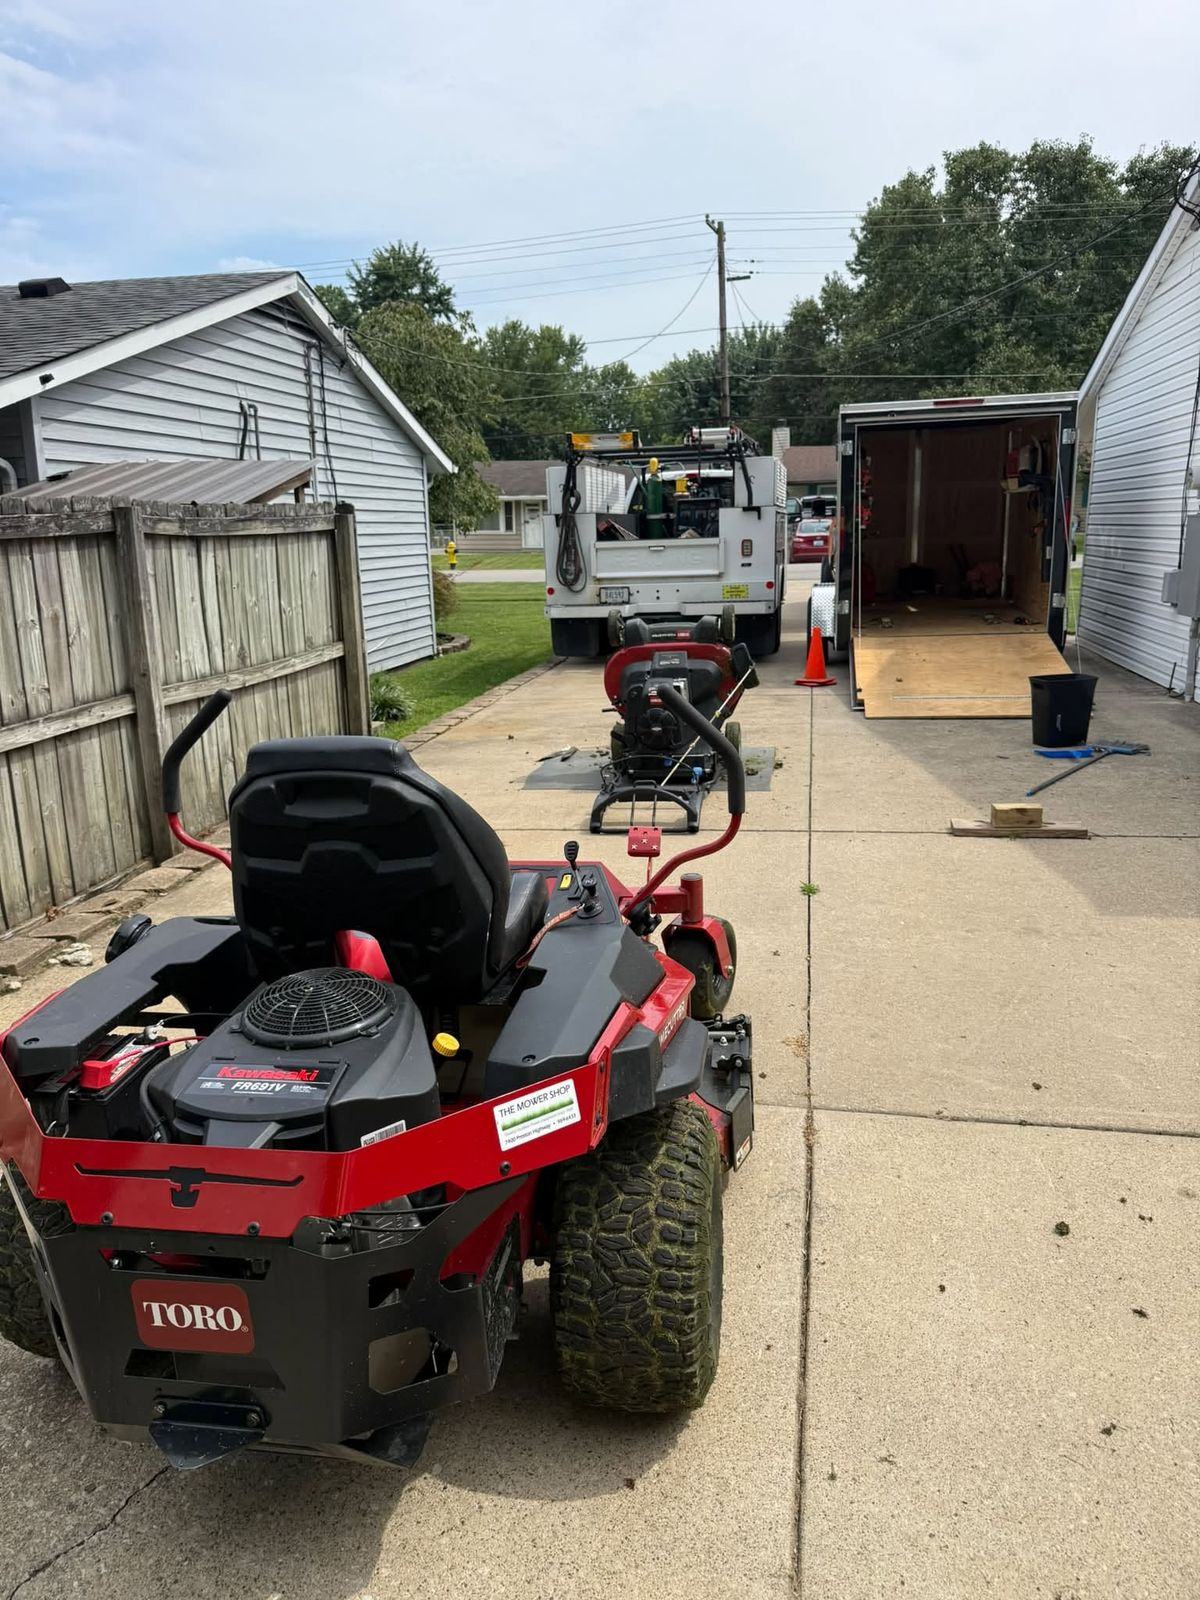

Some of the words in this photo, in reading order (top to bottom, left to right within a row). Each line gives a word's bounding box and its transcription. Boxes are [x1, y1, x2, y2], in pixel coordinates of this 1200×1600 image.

[217, 1066, 319, 1081] Kawasaki
[231, 1081, 286, 1092] FR691V
[498, 1105, 516, 1118] THE
[517, 1092, 549, 1112] MOWER
[549, 1084, 570, 1099] SHOP
[142, 1301, 243, 1331] TORO
